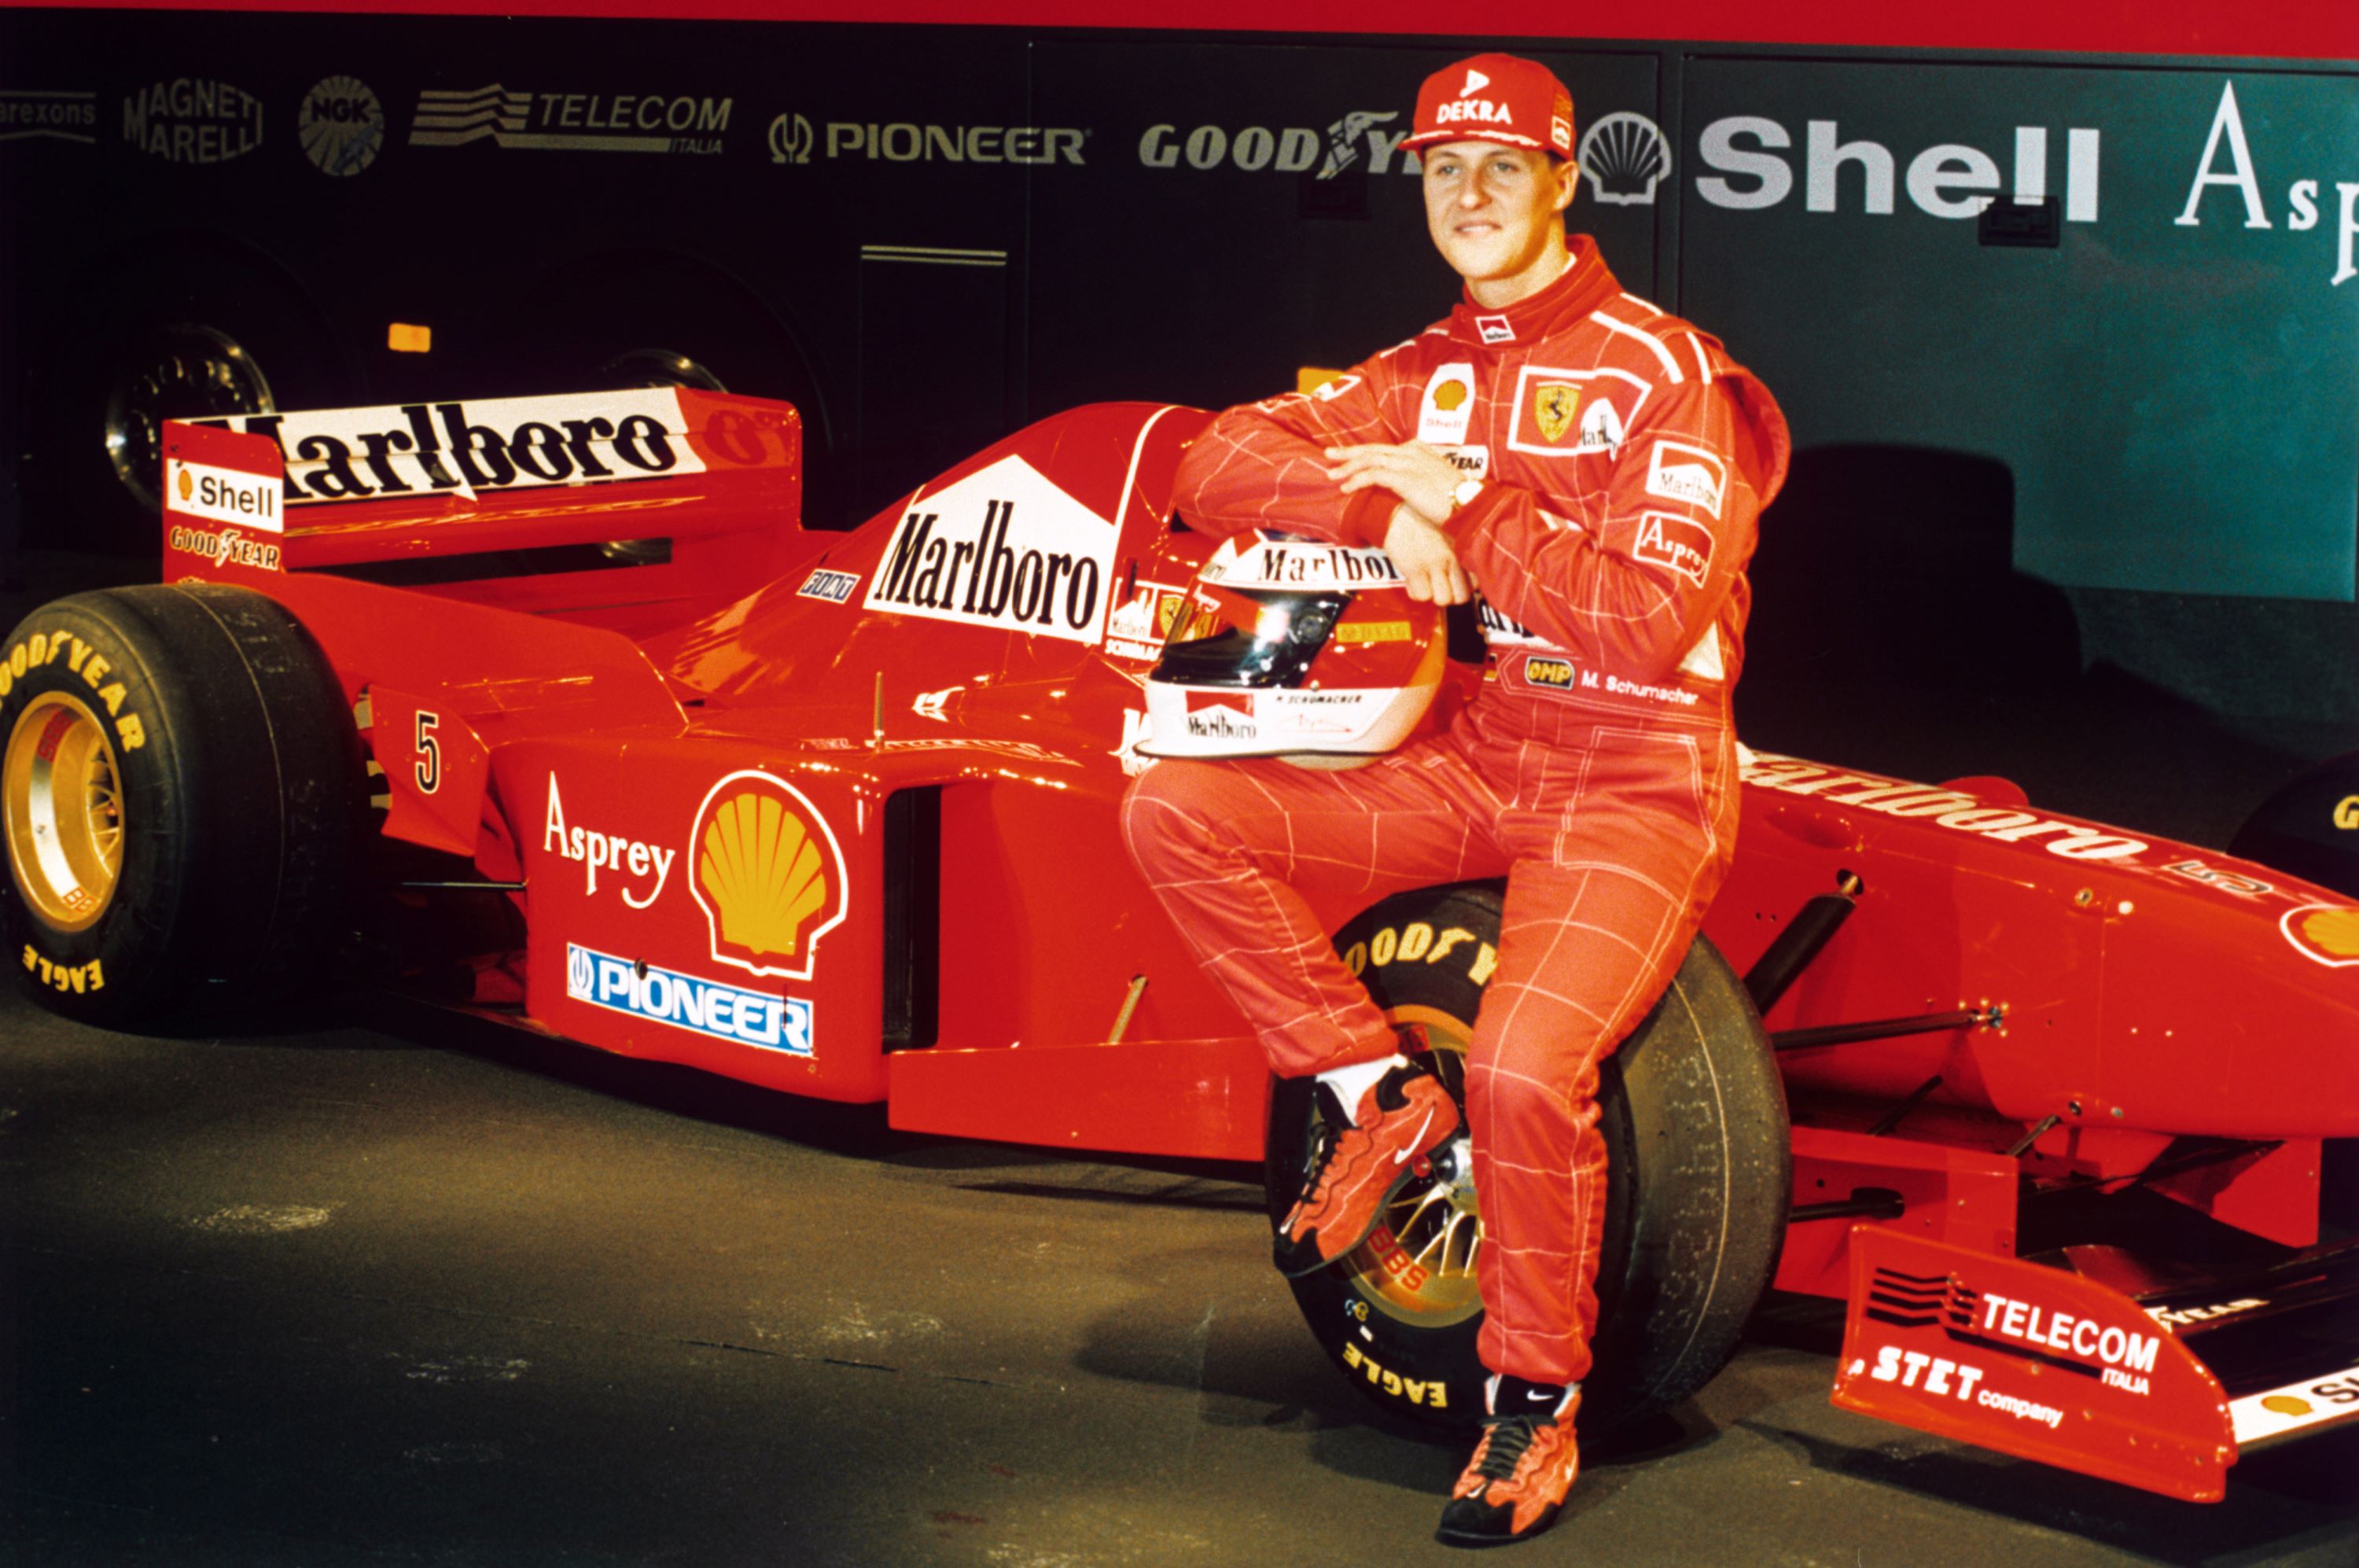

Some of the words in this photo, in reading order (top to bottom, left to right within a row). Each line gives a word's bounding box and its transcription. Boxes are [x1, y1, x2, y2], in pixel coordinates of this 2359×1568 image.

[312, 98, 373, 123] NGK
[539, 94, 733, 132] TELECOM
[1436, 99, 1512, 125] DEKRA
[668, 138, 723, 155] ITALIA
[826, 123, 1086, 164] PIONEER
[1695, 116, 2100, 222] Shell
[1426, 417, 1462, 429] Shell
[200, 476, 273, 517] Shell
[170, 526, 280, 570] GOODYEAR
[873, 499, 1099, 630] Marlboro
[800, 571, 857, 602] FIAT
[0, 630, 145, 753] OODYEAR
[1527, 661, 1572, 684] OMP
[1581, 669, 1599, 689] M.
[1605, 675, 1698, 705] Schumacher
[414, 710, 442, 794] 5
[543, 770, 675, 909] Asprey
[22, 944, 105, 994] EAGLE
[598, 964, 811, 1051] PIONEER
[1367, 1224, 1430, 1292] BBS
[1982, 1293, 2160, 1373] TELECOM
[1341, 1342, 1448, 1409] EAGLE
[1871, 1345, 1984, 1401] STET
[1977, 1389, 2064, 1429] company
[2100, 1367, 2150, 1396] ITALIA
